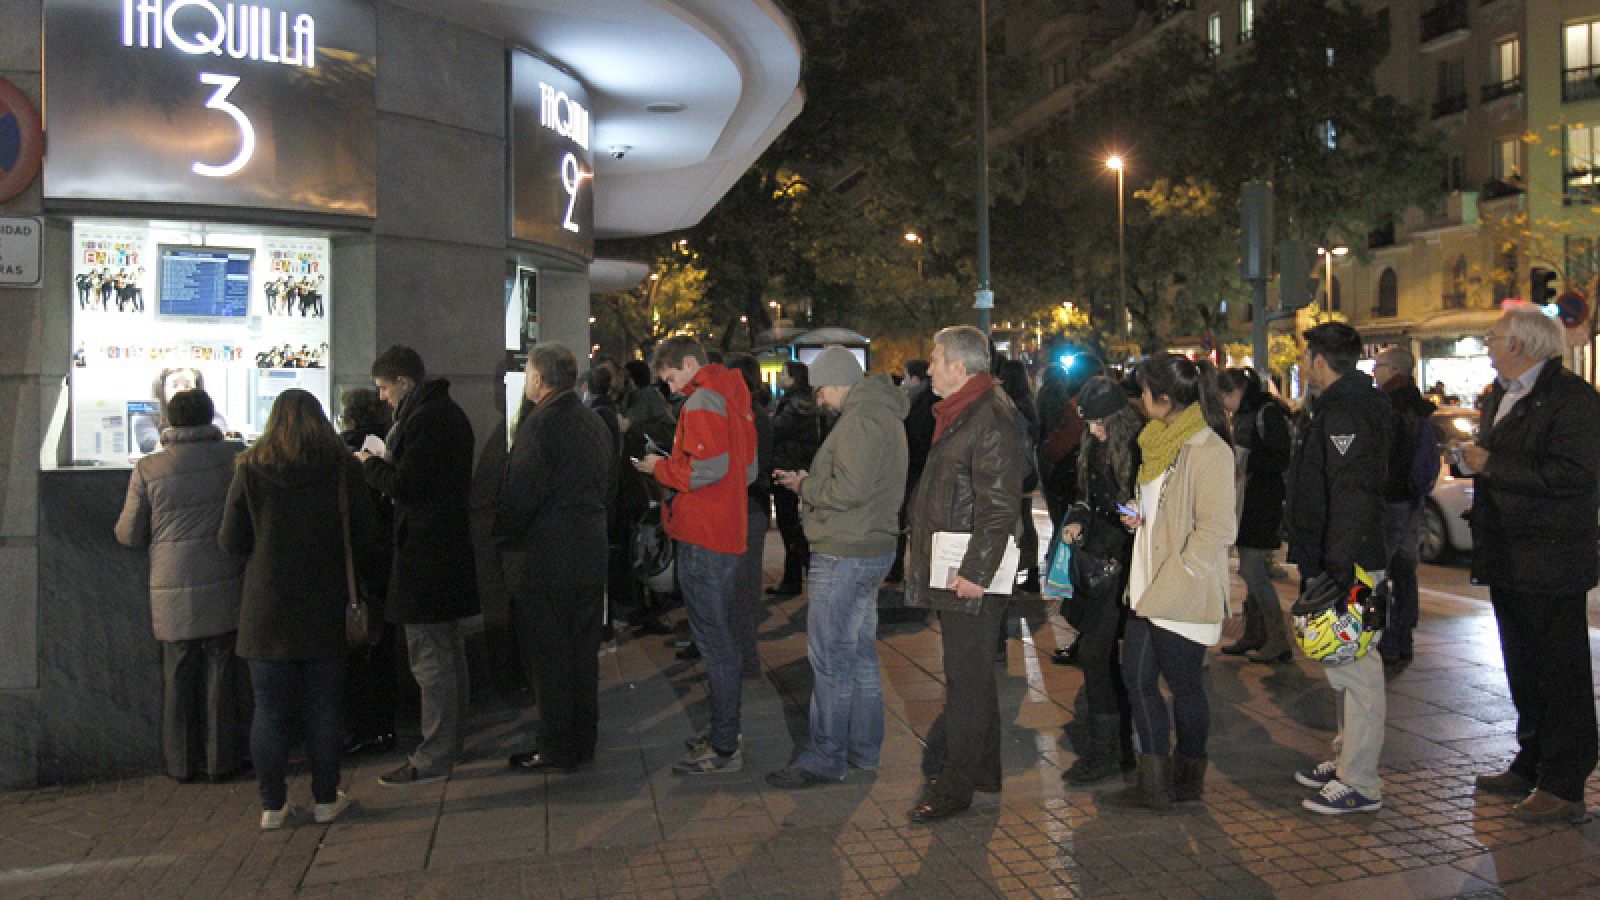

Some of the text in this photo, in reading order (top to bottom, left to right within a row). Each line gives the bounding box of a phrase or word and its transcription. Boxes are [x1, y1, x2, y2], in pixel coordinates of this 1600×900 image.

[121, 0, 315, 68] TAQUILLA
[193, 73, 255, 177] 3
[562, 153, 580, 233] 2
